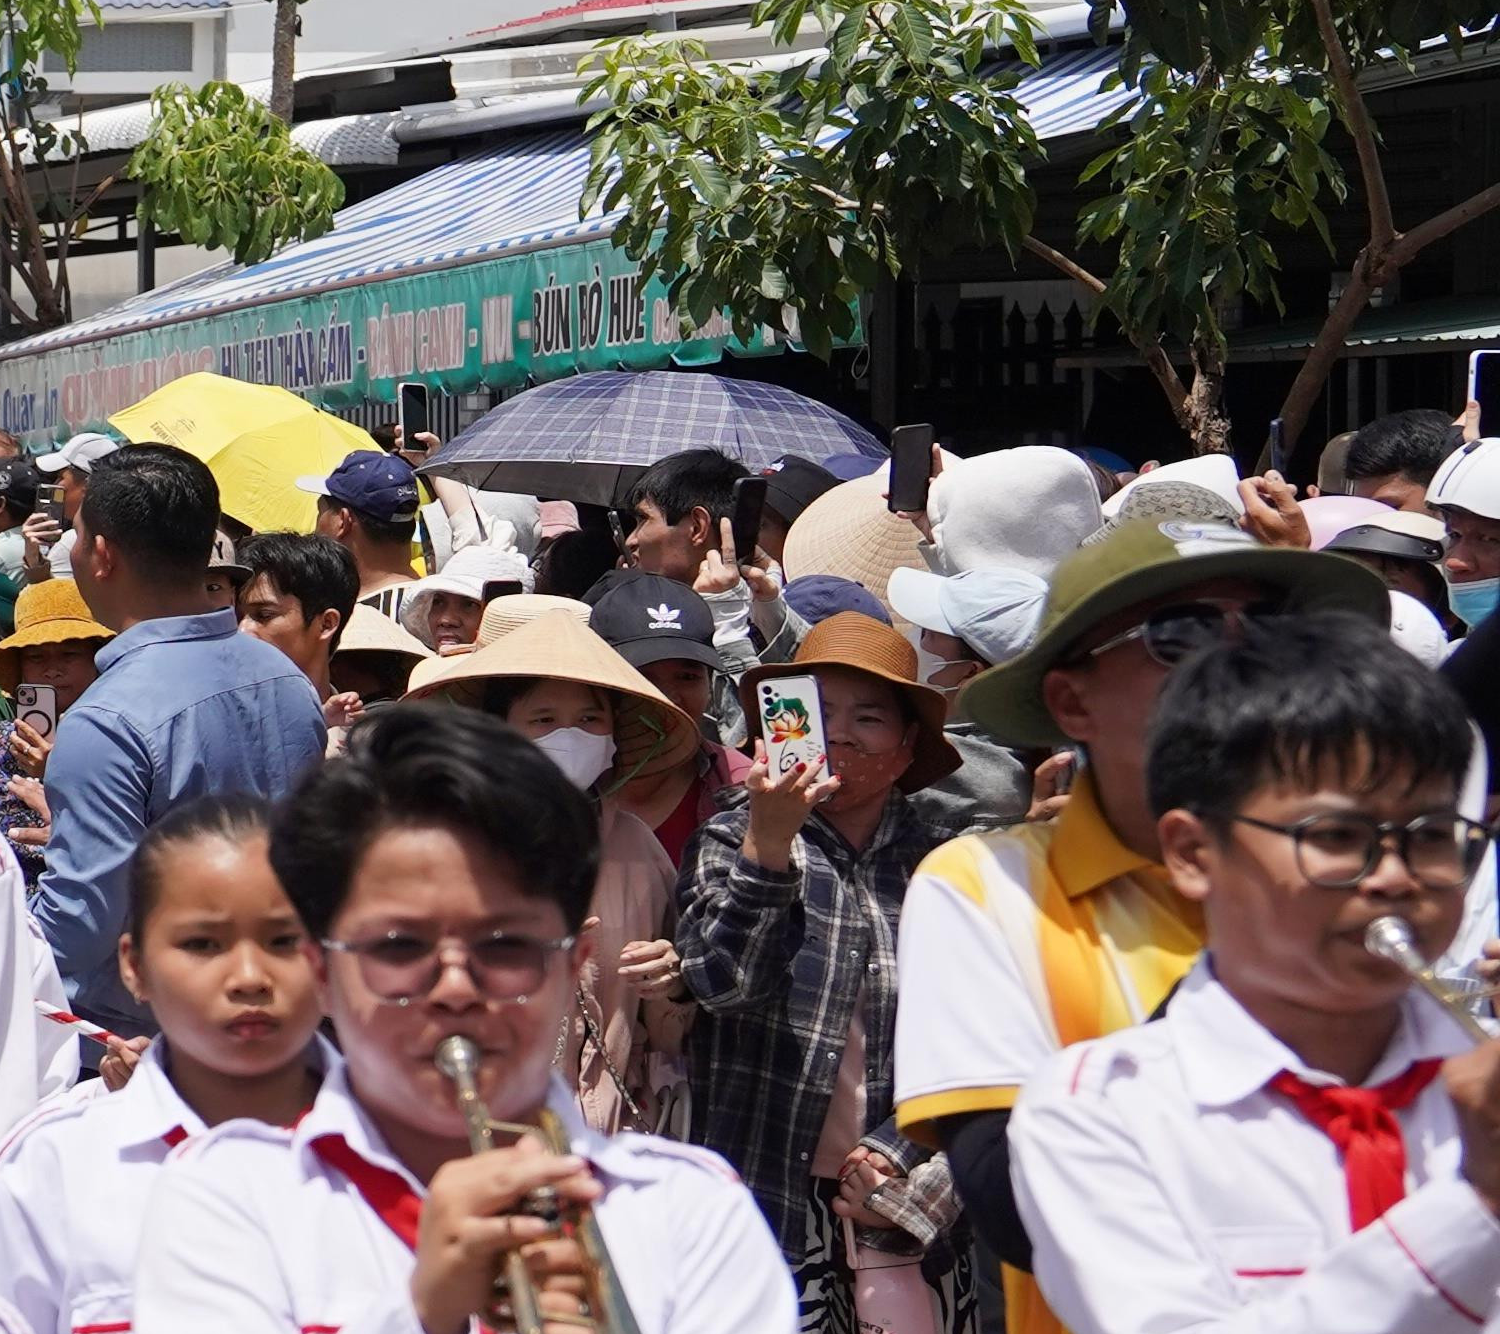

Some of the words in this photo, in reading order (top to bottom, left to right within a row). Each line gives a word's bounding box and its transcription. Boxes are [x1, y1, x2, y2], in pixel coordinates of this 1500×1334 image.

[367, 302, 414, 380] BÁNH
[416, 302, 467, 373] CANH
[532, 272, 572, 357] BÚN
[578, 266, 603, 351] BÒ
